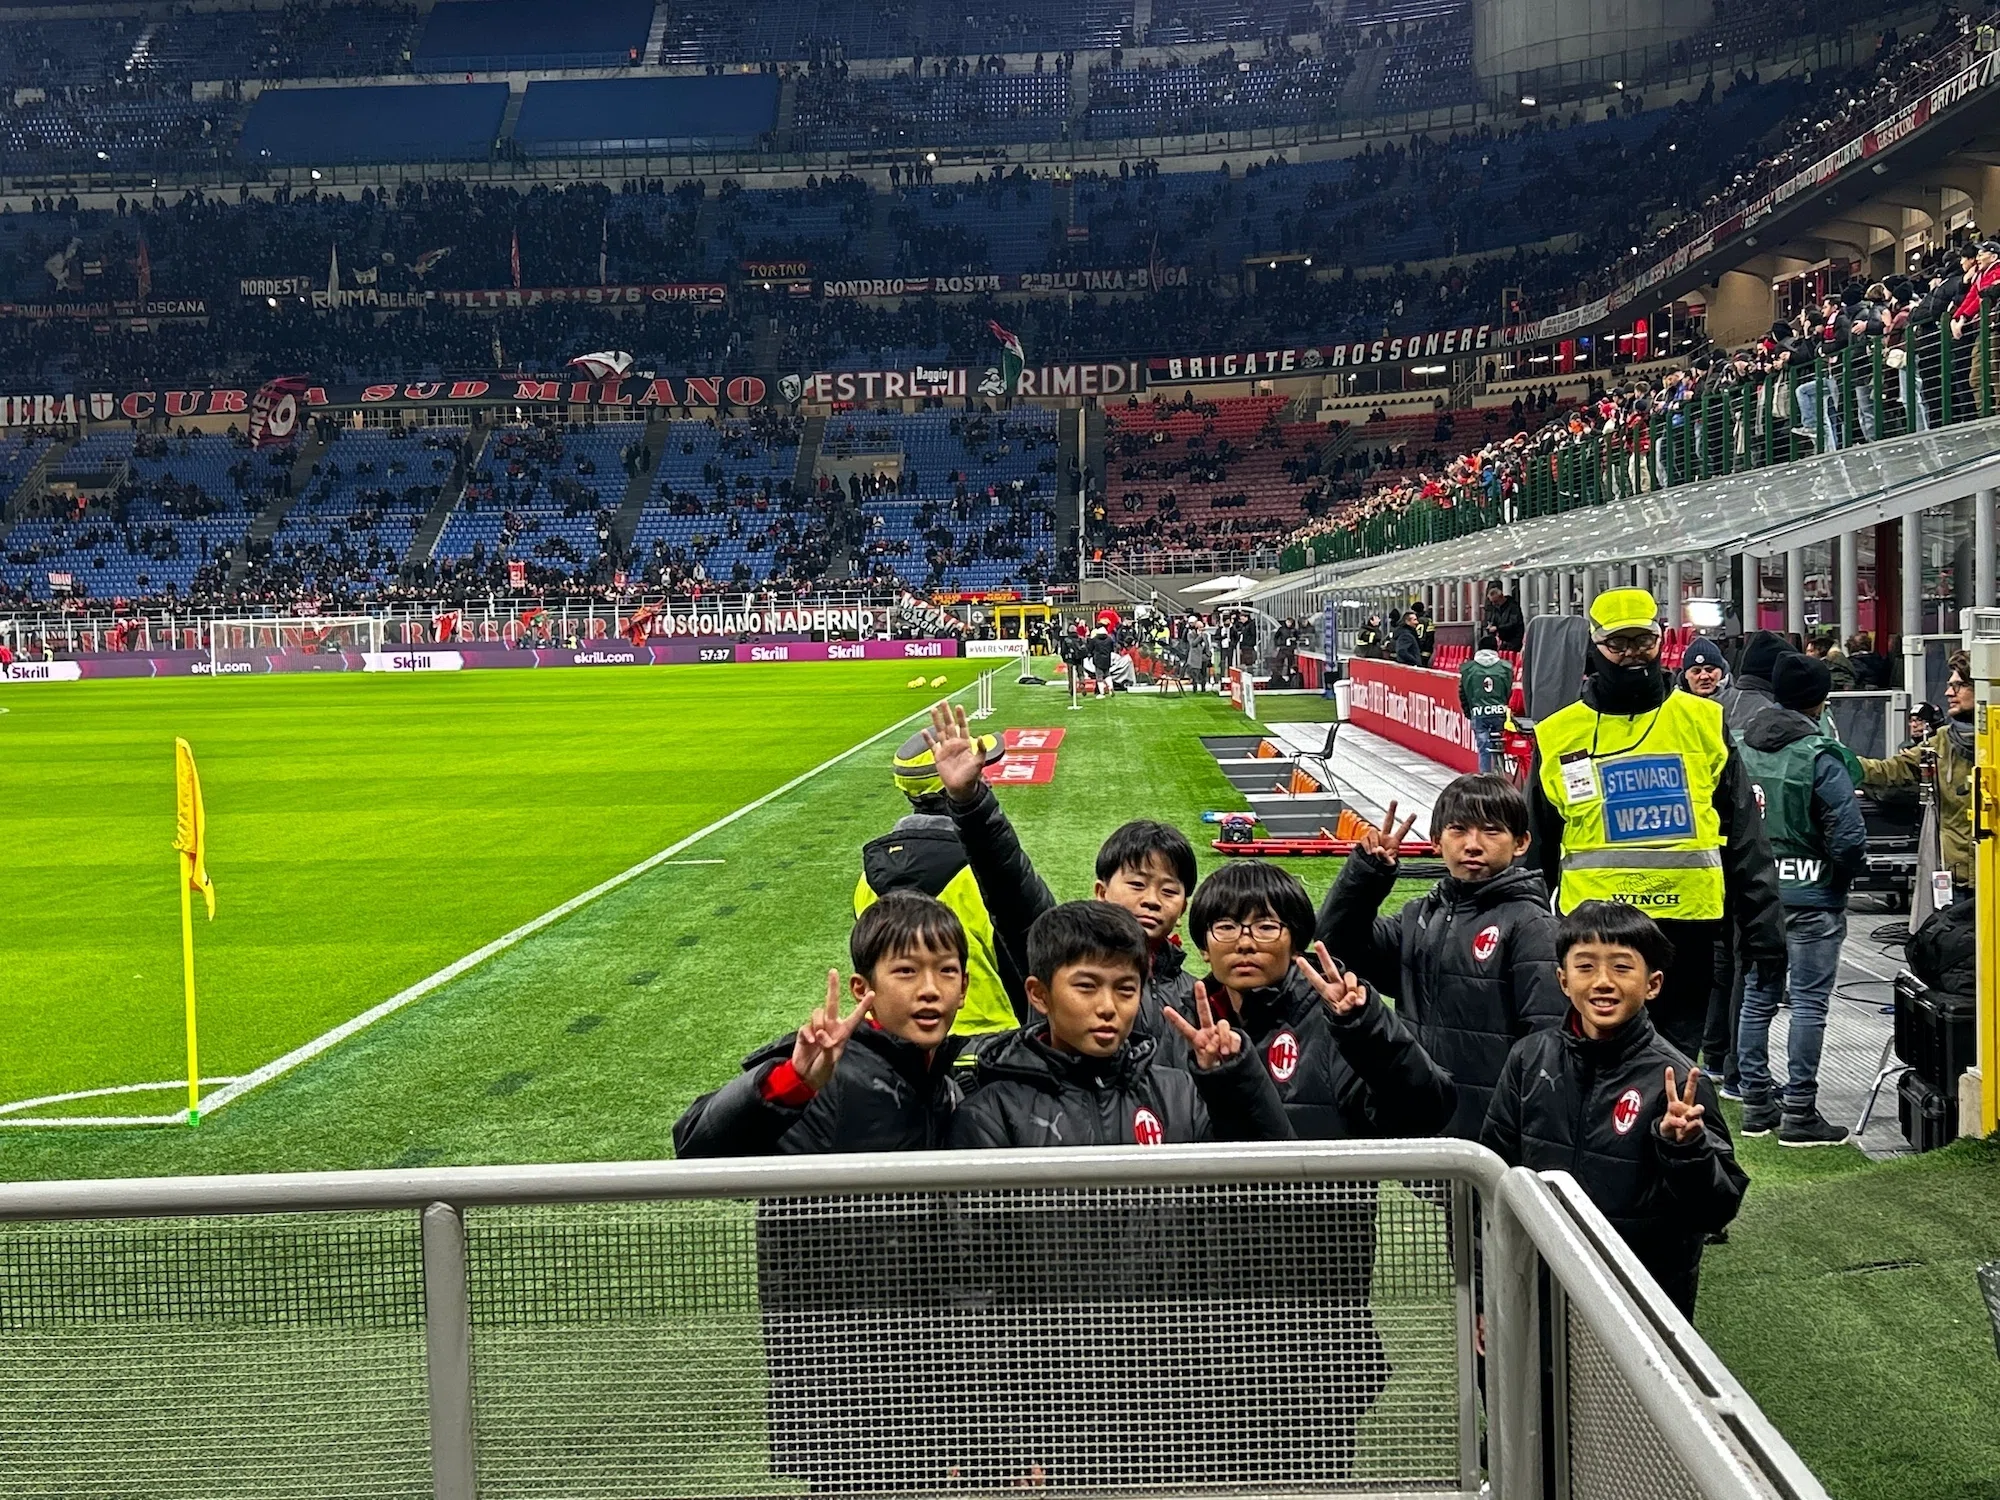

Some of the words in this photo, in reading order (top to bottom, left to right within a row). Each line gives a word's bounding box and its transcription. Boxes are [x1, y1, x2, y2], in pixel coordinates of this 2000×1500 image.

[1930, 67, 1978, 115] GATTICO
[749, 263, 807, 278] TORINO
[240, 279, 298, 296] NORDEST
[823, 278, 905, 298] SONDRIO
[934, 274, 1001, 293] AOSTA
[651, 286, 725, 304] QUARTO
[1168, 350, 1296, 381] BRIGATE
[1332, 324, 1491, 368] ROSSONERE
[915, 365, 949, 384] Baggio
[1016, 361, 1139, 398] RIMEDI
[121, 382, 330, 419] CURA
[361, 381, 490, 403] SUD
[513, 376, 767, 407] MILANO
[764, 608, 875, 635] MADERNO
[573, 652, 635, 664] skrill.com
[700, 649, 730, 662] 57:37
[751, 646, 788, 661] Skrill
[828, 644, 865, 660] Skrill
[904, 642, 942, 658] Skrill
[393, 656, 431, 669] Skrill
[12, 666, 49, 680] Skrill
[1384, 684, 1409, 725] Emirates
[1429, 696, 1461, 745] Emirates
[1472, 706, 1483, 716] TV
[1607, 767, 1680, 795] STEWARD
[1614, 803, 1687, 832] W2370
[1612, 893, 1681, 906] WINCH
